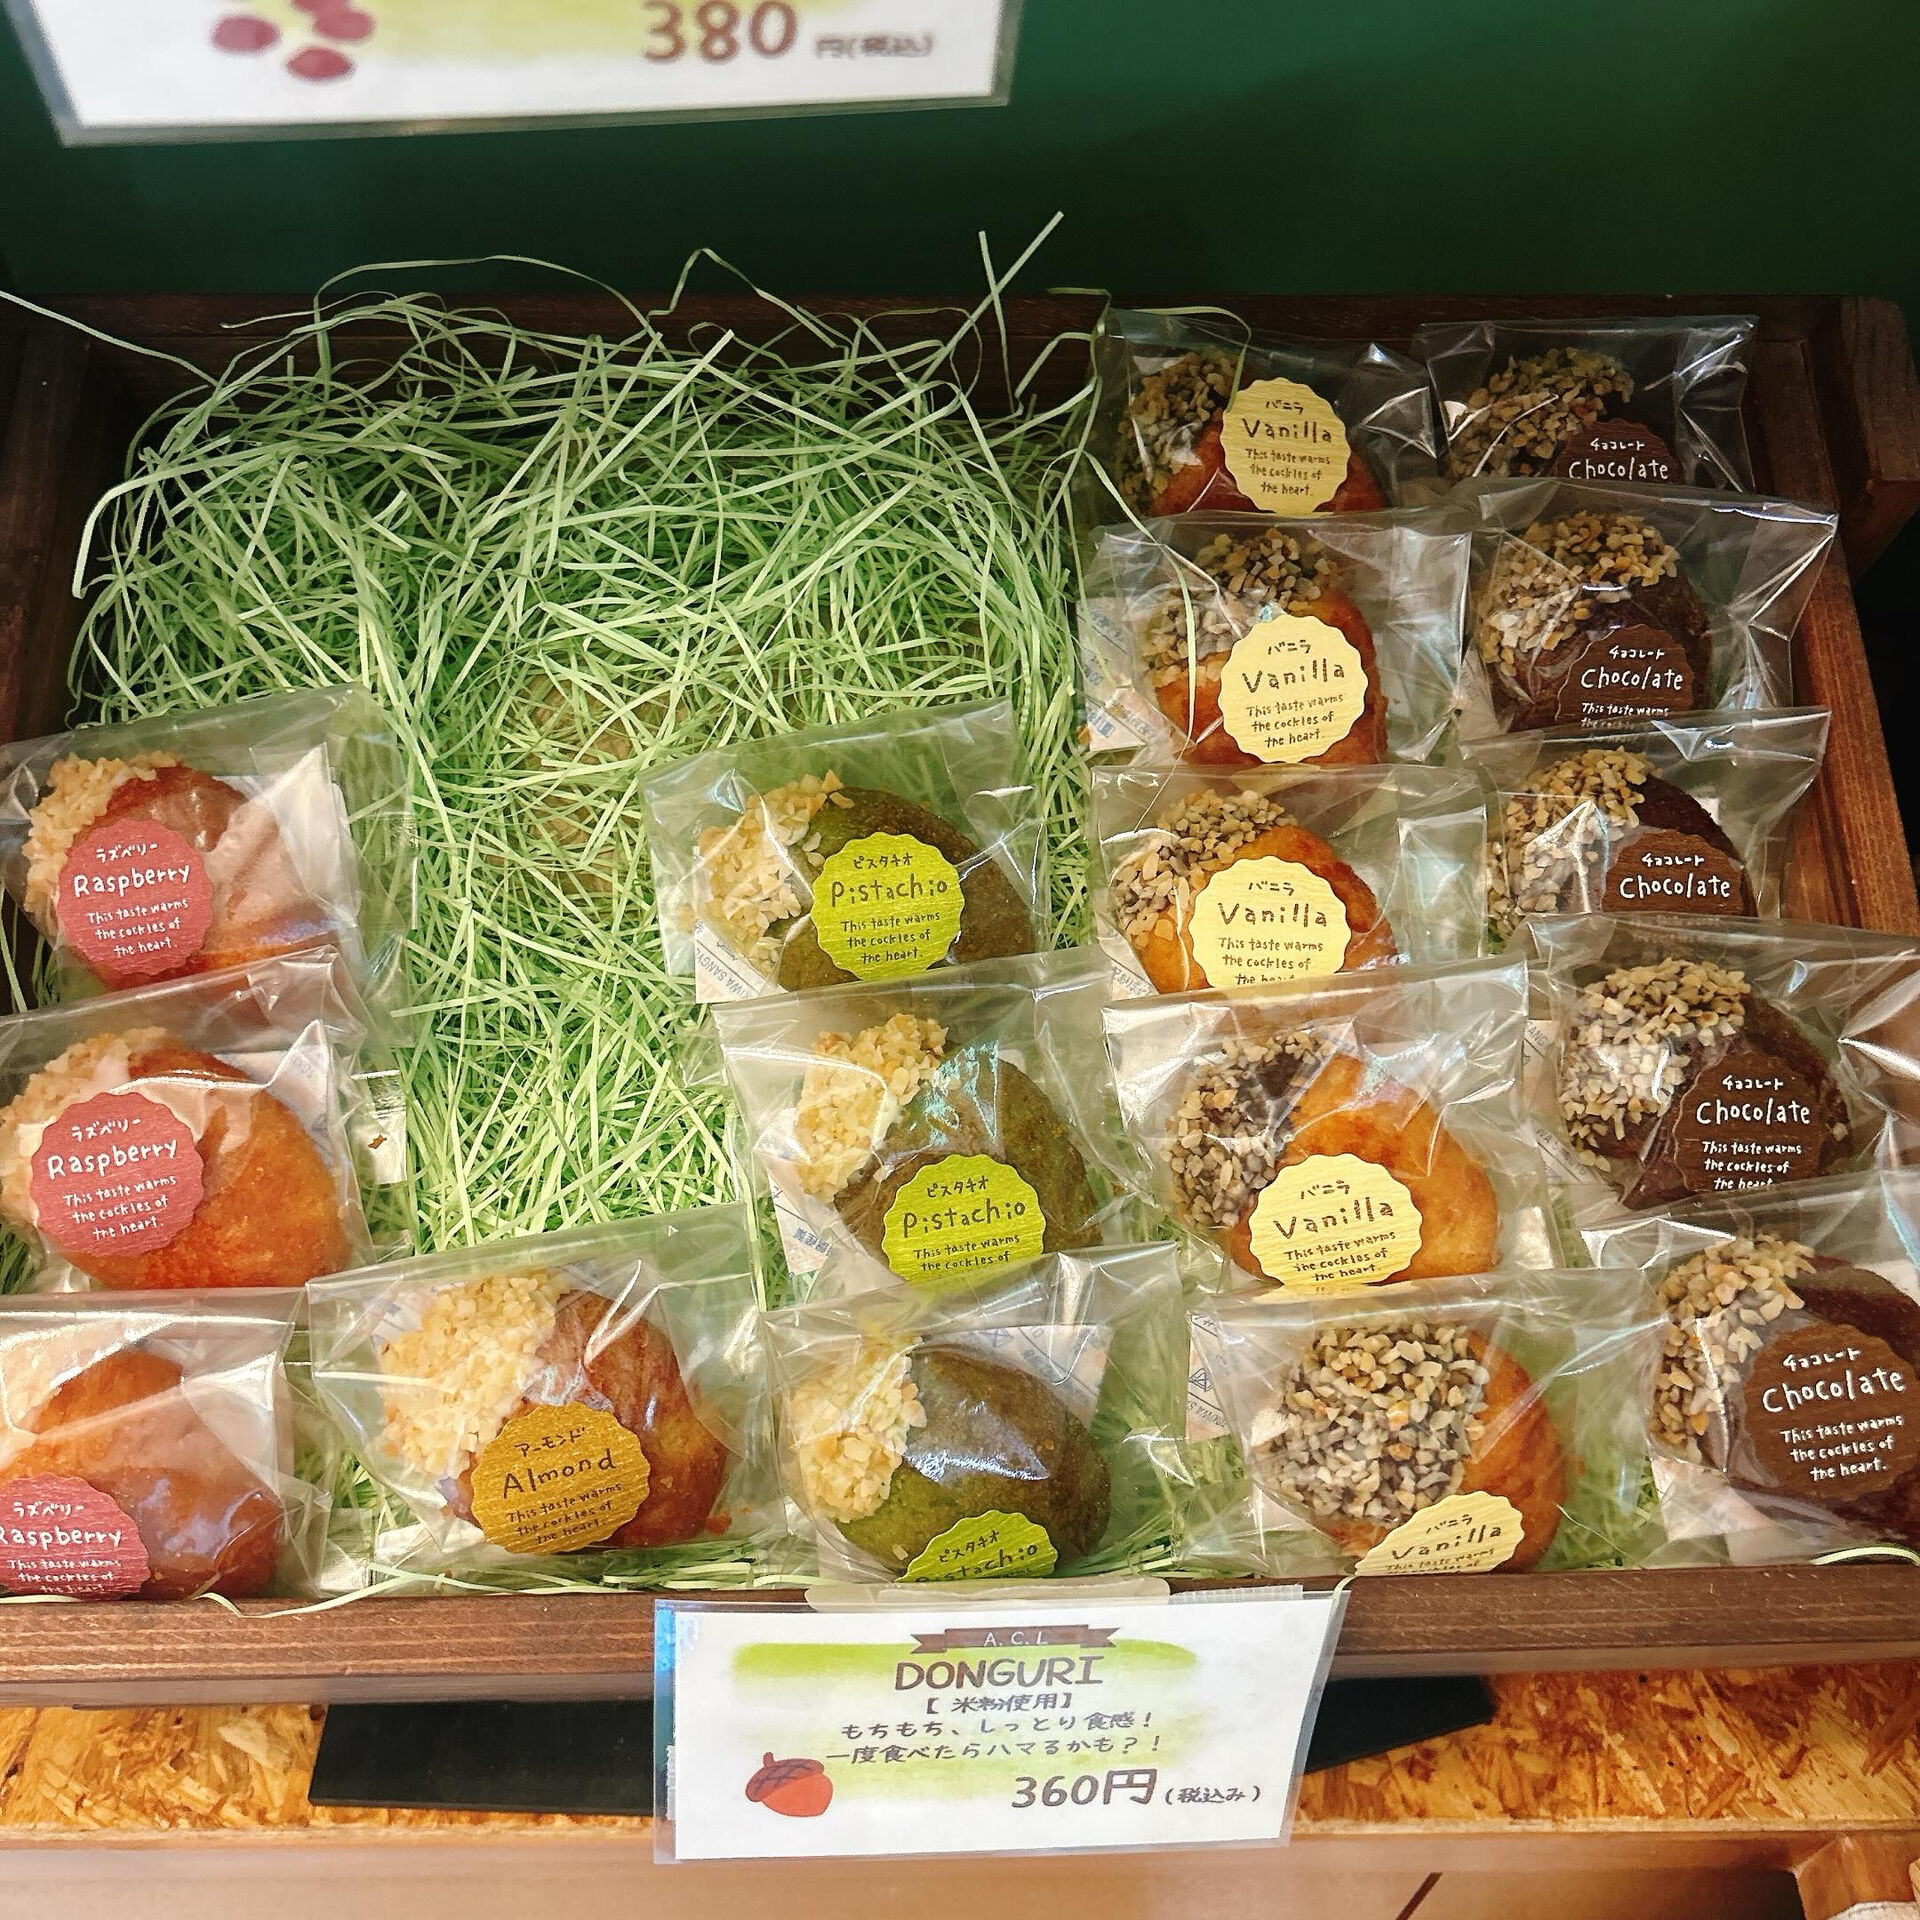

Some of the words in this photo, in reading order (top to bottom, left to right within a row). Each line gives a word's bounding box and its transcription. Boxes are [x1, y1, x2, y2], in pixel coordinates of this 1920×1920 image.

[644, 0, 797, 64] 380
[1265, 399, 1304, 414] バニラ
[1241, 417, 1332, 443] Vanilla
[1245, 448, 1268, 461] This
[1270, 449, 1297, 464] taste
[1300, 453, 1330, 465] warms
[1249, 464, 1267, 477] the
[1269, 466, 1309, 481] cockles
[1311, 469, 1322, 481] of
[1568, 457, 1669, 480] Chocolate
[1260, 481, 1278, 495] the
[1267, 639, 1312, 655] バニラ
[1241, 658, 1345, 693] Vanilla
[1581, 666, 1683, 690] Chocolate
[1246, 704, 1272, 718] This
[1274, 699, 1305, 714] taste
[1307, 693, 1344, 710] warms
[1582, 702, 1603, 714] This
[1607, 704, 1634, 716] taste
[1637, 707, 1669, 717] warms
[1251, 719, 1272, 732] the
[1274, 714, 1319, 730] cockles
[1322, 711, 1335, 724] of
[1264, 735, 1286, 748] the
[96, 842, 159, 863] ラズベリー
[854, 852, 913, 870] ピスタチオ
[73, 864, 190, 898] Raspberry
[1248, 881, 1295, 896] バニラ
[1619, 872, 1730, 899] Chocolate
[87, 911, 113, 924] This
[116, 906, 148, 920] taste
[150, 897, 188, 914] warms
[840, 920, 867, 933] This
[872, 916, 901, 930] taste
[904, 911, 940, 926] warms
[1217, 902, 1328, 927] Vanilla
[95, 928, 116, 941] the
[119, 920, 165, 939] cockles
[169, 916, 181, 930] of
[847, 936, 868, 949] the
[870, 932, 916, 946] cockles
[919, 928, 932, 942] of
[114, 944, 135, 958] the
[1218, 937, 1246, 951] This
[1248, 938, 1282, 951] taste
[1283, 940, 1324, 952] warms
[861, 952, 882, 964] the
[1222, 954, 1243, 967] the
[1246, 955, 1295, 969] cockles
[1297, 957, 1312, 970] of
[1235, 973, 1255, 985] the
[1696, 1098, 1811, 1125] Chocolate
[71, 1118, 142, 1142] ラズベリー
[47, 1139, 177, 1180] Raspberry
[1702, 1141, 1728, 1154] This
[1731, 1142, 1762, 1155] taste
[1765, 1144, 1802, 1155] warms
[1704, 1158, 1723, 1171] the
[1727, 1160, 1772, 1174] cockles
[1776, 1161, 1790, 1174] of
[64, 1193, 93, 1207] This
[96, 1185, 131, 1201] taste
[134, 1176, 176, 1191] warms
[926, 1175, 990, 1198] ピスタチオ
[1300, 1180, 1350, 1199] バニラ
[1714, 1177, 1733, 1190] the
[73, 1212, 96, 1224] the
[99, 1200, 151, 1220] cockles
[155, 1194, 168, 1209] of
[1273, 1197, 1394, 1239] Vanilla
[93, 1226, 116, 1241] the
[913, 1248, 940, 1260] This
[944, 1242, 977, 1256] taste
[980, 1234, 1020, 1250] warms
[1284, 1249, 1314, 1261] This
[1316, 1241, 1350, 1256] taste
[1353, 1232, 1396, 1248] warms
[922, 1260, 940, 1272] the
[945, 1256, 994, 1270] cockles
[996, 1250, 1010, 1263] of
[1294, 1259, 1316, 1272] the
[1320, 1251, 1370, 1269] cockles
[1374, 1247, 1388, 1260] of
[1313, 1270, 1334, 1282] the
[1762, 1367, 1905, 1413] Chocolate
[515, 1425, 585, 1457] アーモンド
[1780, 1429, 1813, 1444] This
[1816, 1421, 1853, 1440] taste
[1856, 1415, 1904, 1432] warms
[1790, 1448, 1815, 1463] the
[1819, 1440, 1875, 1459] cockles
[1878, 1435, 1895, 1450] of
[503, 1448, 617, 1499] Almond
[1810, 1465, 1835, 1482] the
[13, 1501, 84, 1518] ラズベリー
[507, 1508, 537, 1523] This
[539, 1498, 576, 1515] taste
[580, 1483, 622, 1501] warms
[517, 1524, 539, 1536] the
[599, 1500, 612, 1512] of
[1426, 1514, 1472, 1535] バニラ
[535, 1532, 558, 1545] the
[938, 1530, 1000, 1564] ピスタチオ
[1391, 1524, 1502, 1560] Vanilla
[7, 1559, 37, 1570] This
[40, 1559, 75, 1569] taste
[18, 1572, 41, 1582] the
[101, 1571, 115, 1581] of
[895, 1655, 1105, 1691] DONGURI
[1011, 1768, 1158, 1808] 360円
